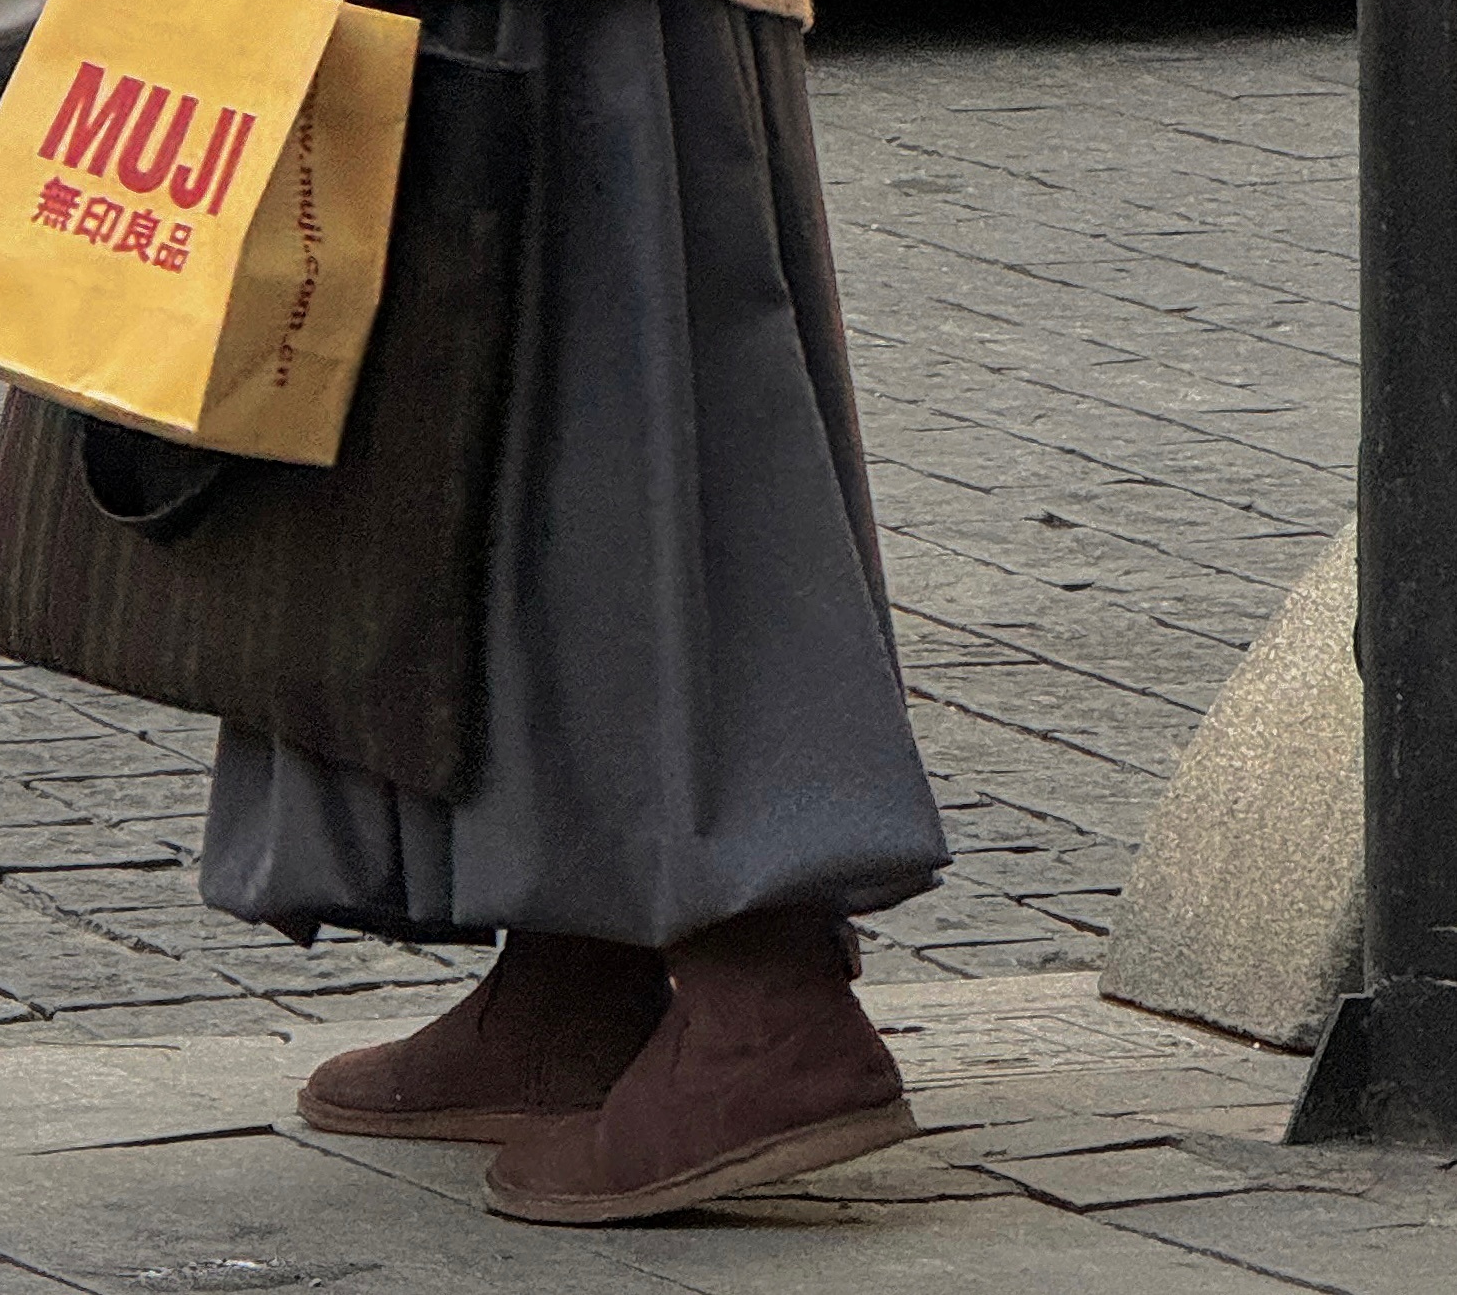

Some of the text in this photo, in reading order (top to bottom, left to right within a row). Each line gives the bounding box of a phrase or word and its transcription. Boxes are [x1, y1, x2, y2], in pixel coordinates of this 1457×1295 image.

[37, 61, 257, 216] MUJI
[30, 176, 194, 274] 無印良品
